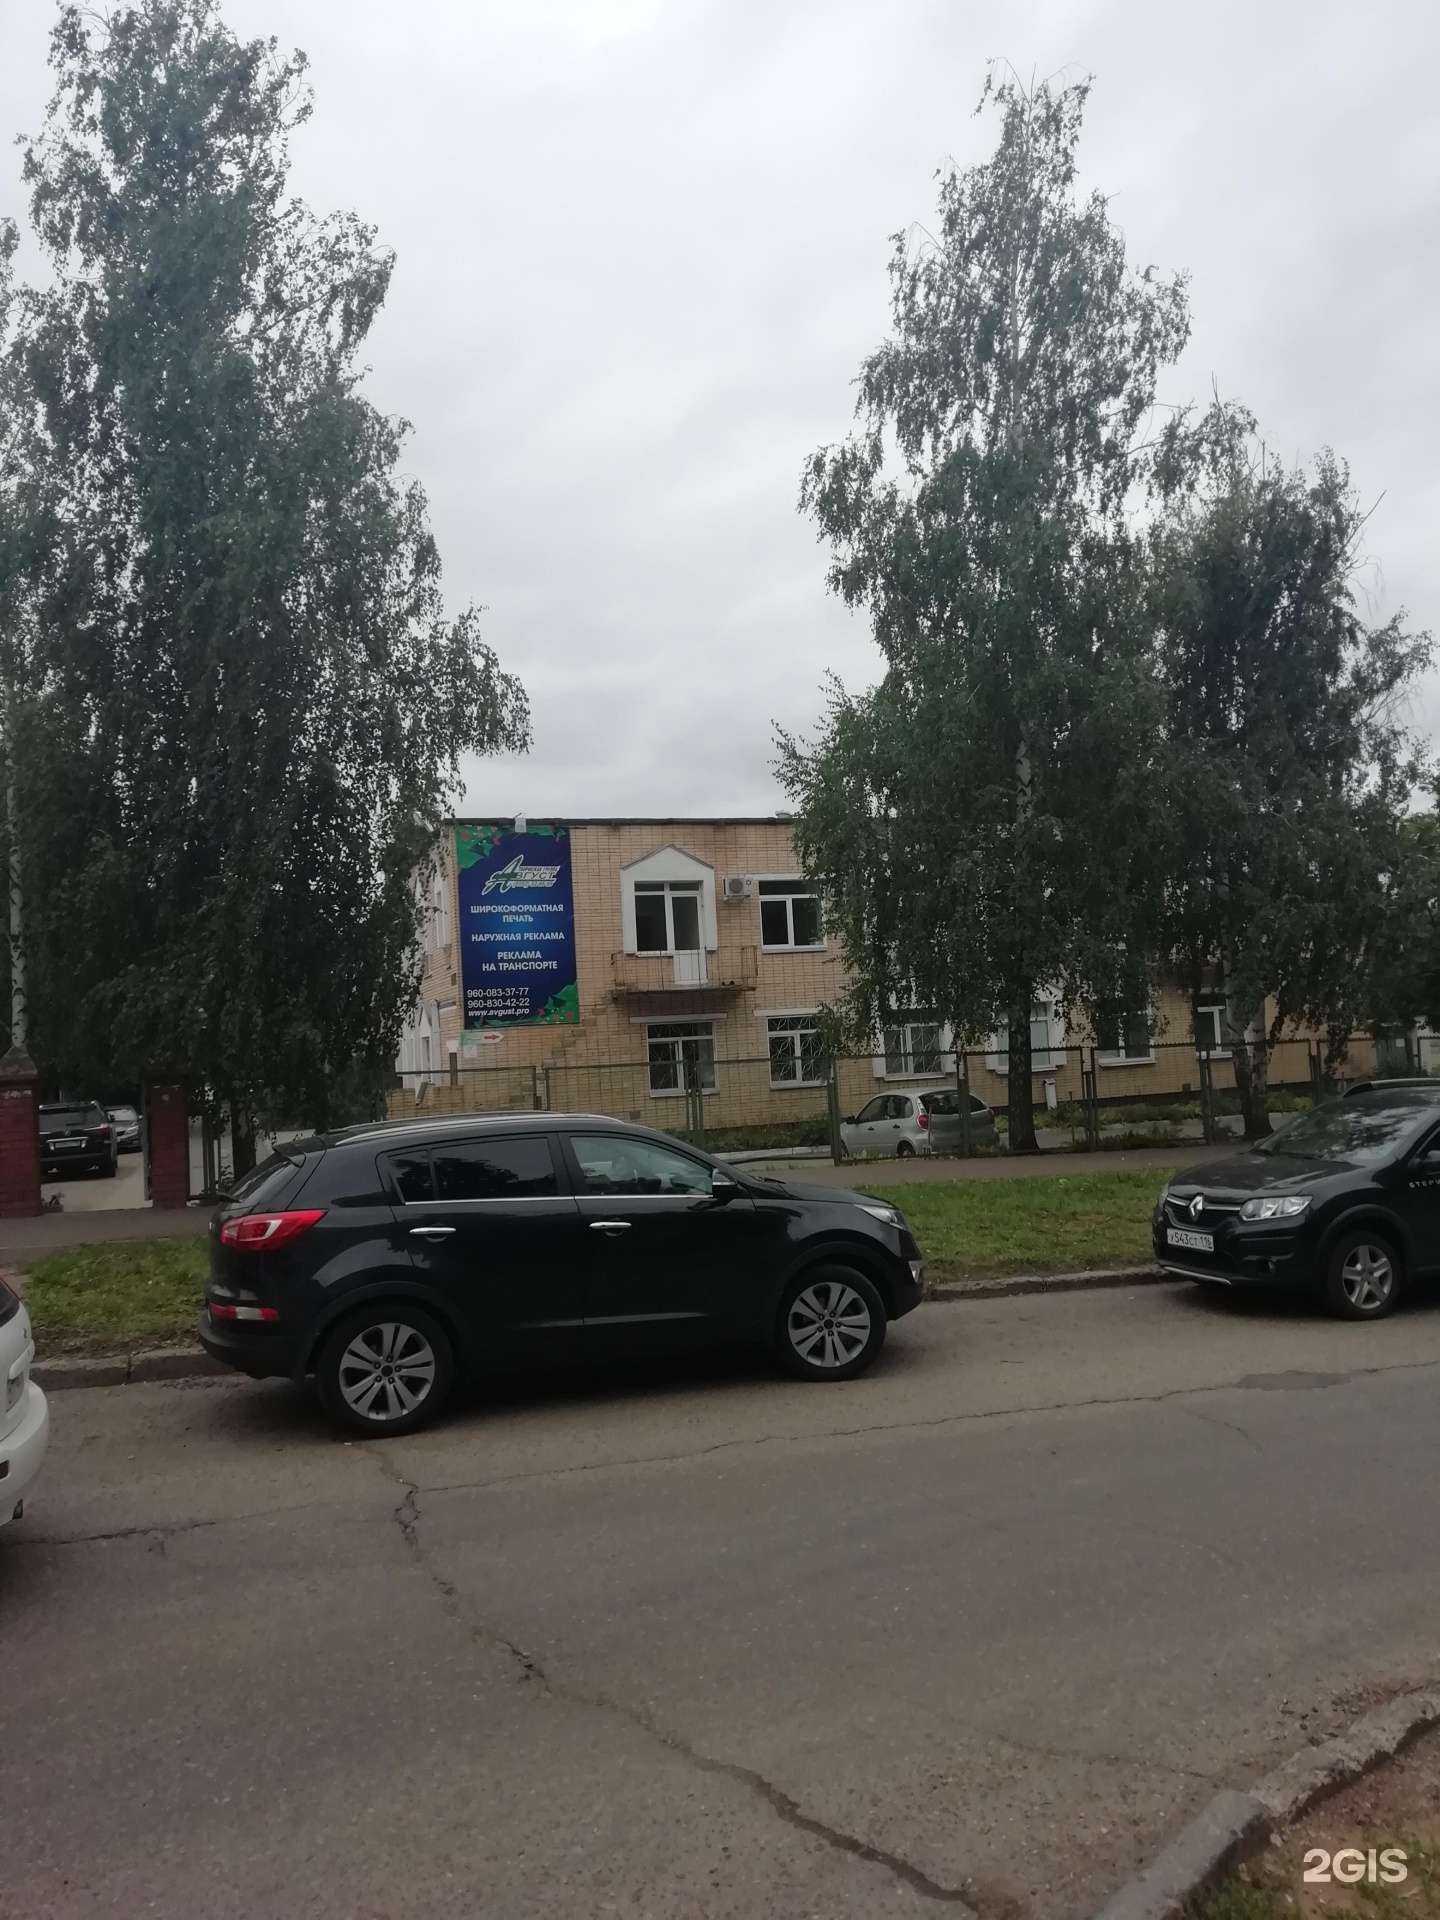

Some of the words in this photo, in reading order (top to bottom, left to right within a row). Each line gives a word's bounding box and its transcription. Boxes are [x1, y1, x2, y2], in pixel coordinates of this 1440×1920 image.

[470, 904, 564, 914] ШИРОКОФОРМАТНАЯ
[502, 915, 534, 923] ПЕЧАТЬ
[471, 933, 522, 942] НАРУЖНАЯ
[523, 932, 565, 941] РЕКЛАМА
[497, 951, 542, 960] РЕКЛАМА
[482, 962, 497, 972] НА
[498, 961, 558, 971] ТРАНСПОРТЕ
[467, 988, 529, 998] 960-083-37-77
[467, 998, 530, 1009] 960-830-42-22
[468, 1008, 530, 1017] www.avgust.pro
